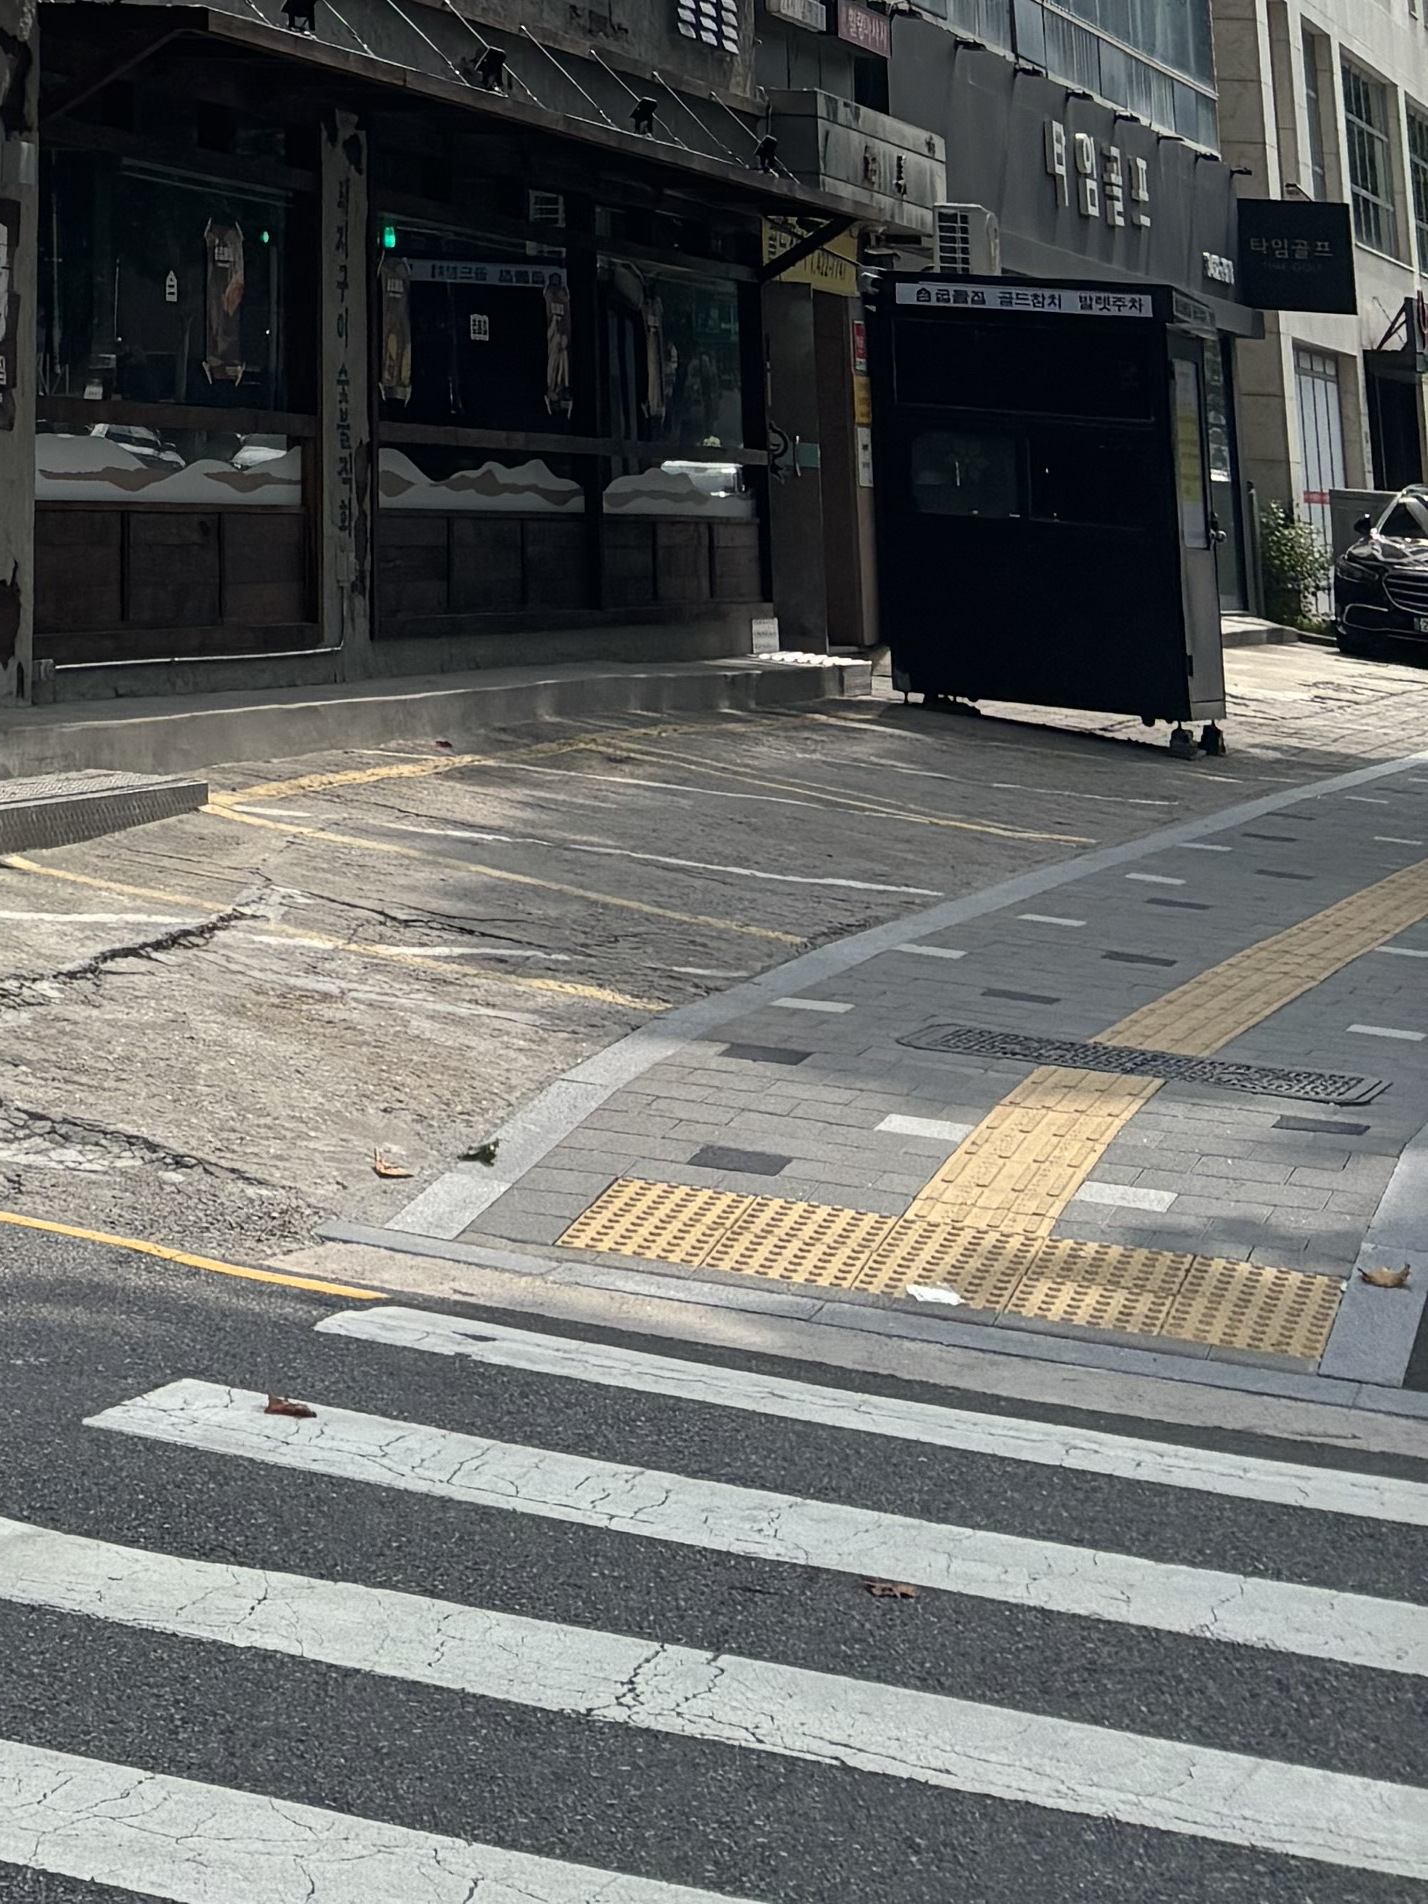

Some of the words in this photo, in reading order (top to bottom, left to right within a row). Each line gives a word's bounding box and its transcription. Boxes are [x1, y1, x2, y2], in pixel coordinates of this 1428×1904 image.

[1047, 120, 1152, 228] 타임골프
[1249, 237, 1334, 260] 타임골프
[1078, 293, 1145, 315] 발렛주차
